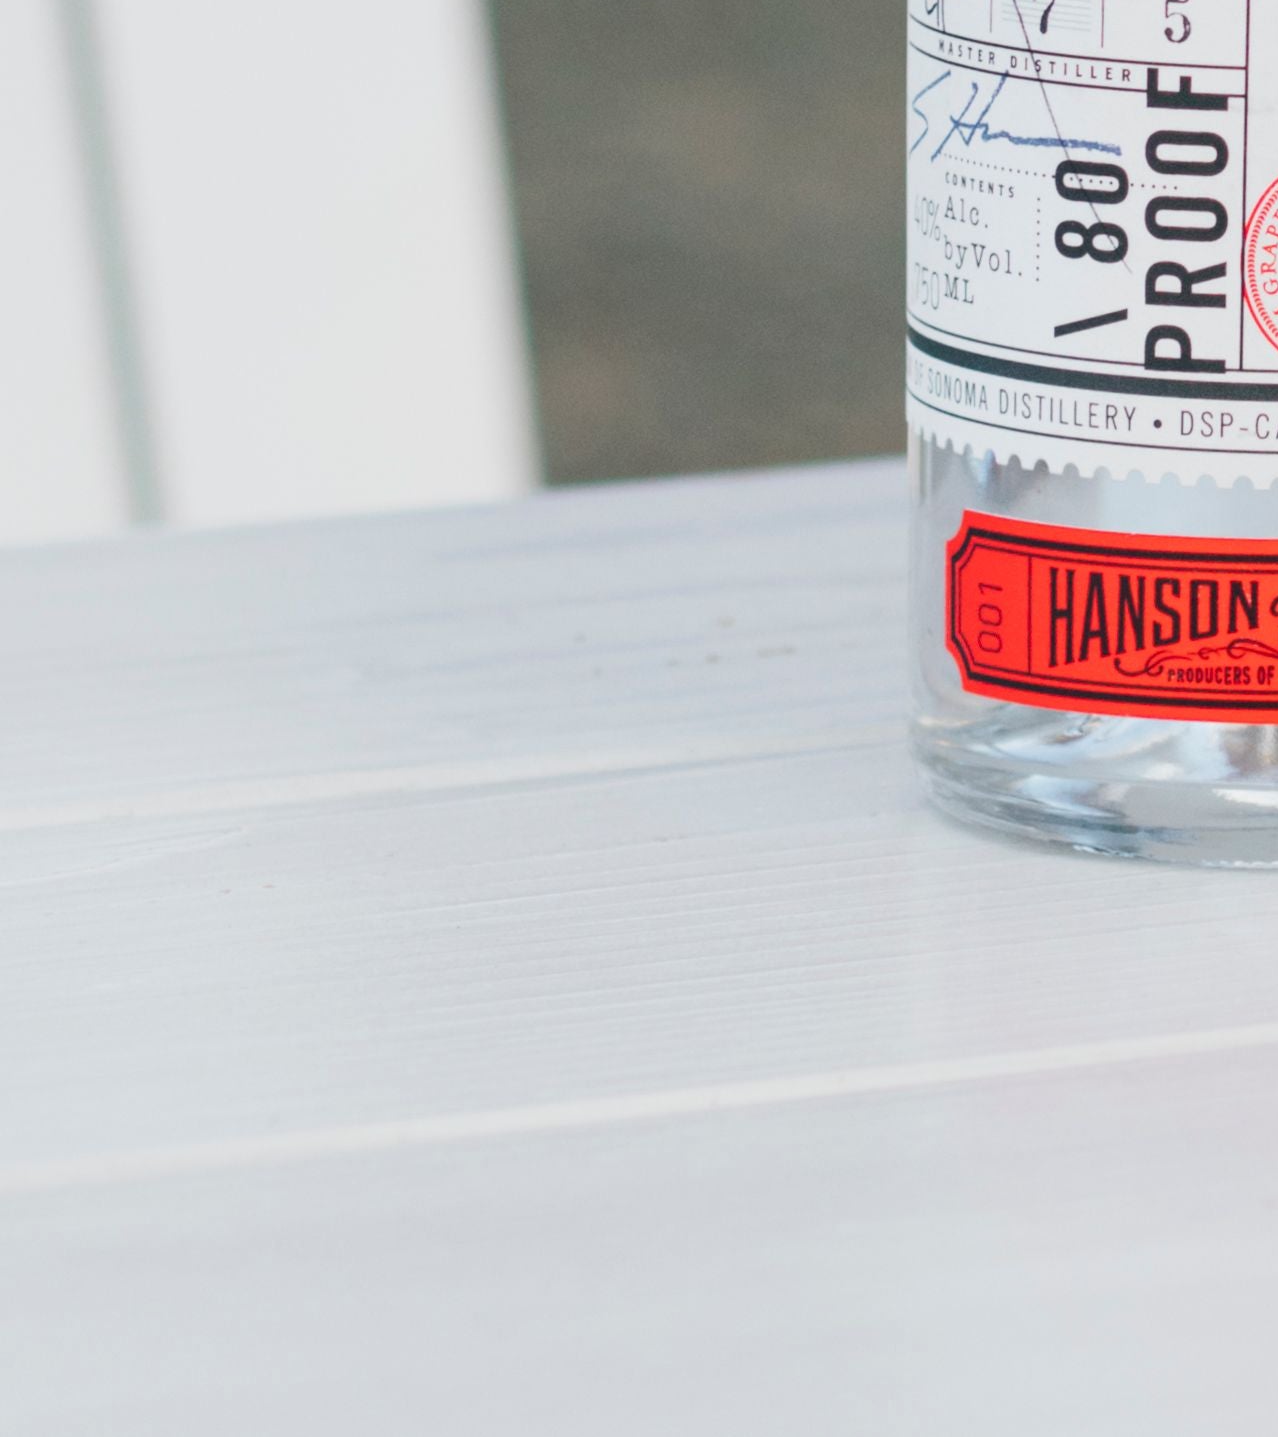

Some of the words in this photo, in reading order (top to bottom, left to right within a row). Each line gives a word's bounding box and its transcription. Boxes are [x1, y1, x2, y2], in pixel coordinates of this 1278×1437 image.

[938, 38, 996, 66] MASTER
[1010, 54, 1132, 83] DISTILLER
[944, 195, 990, 229] Alc.
[945, 171, 1015, 199] CONTENTS
[1054, 159, 1129, 264] 80
[1145, 67, 1229, 375] PROOF
[944, 273, 975, 305] ML
[928, 367, 989, 411] SONOMA
[998, 388, 1137, 432] DISTILLERY
[977, 581, 1004, 655] 001
[1048, 567, 1259, 668] HANSON
[1167, 665, 1251, 685] PRODUCERS
[1256, 666, 1274, 686] OF
